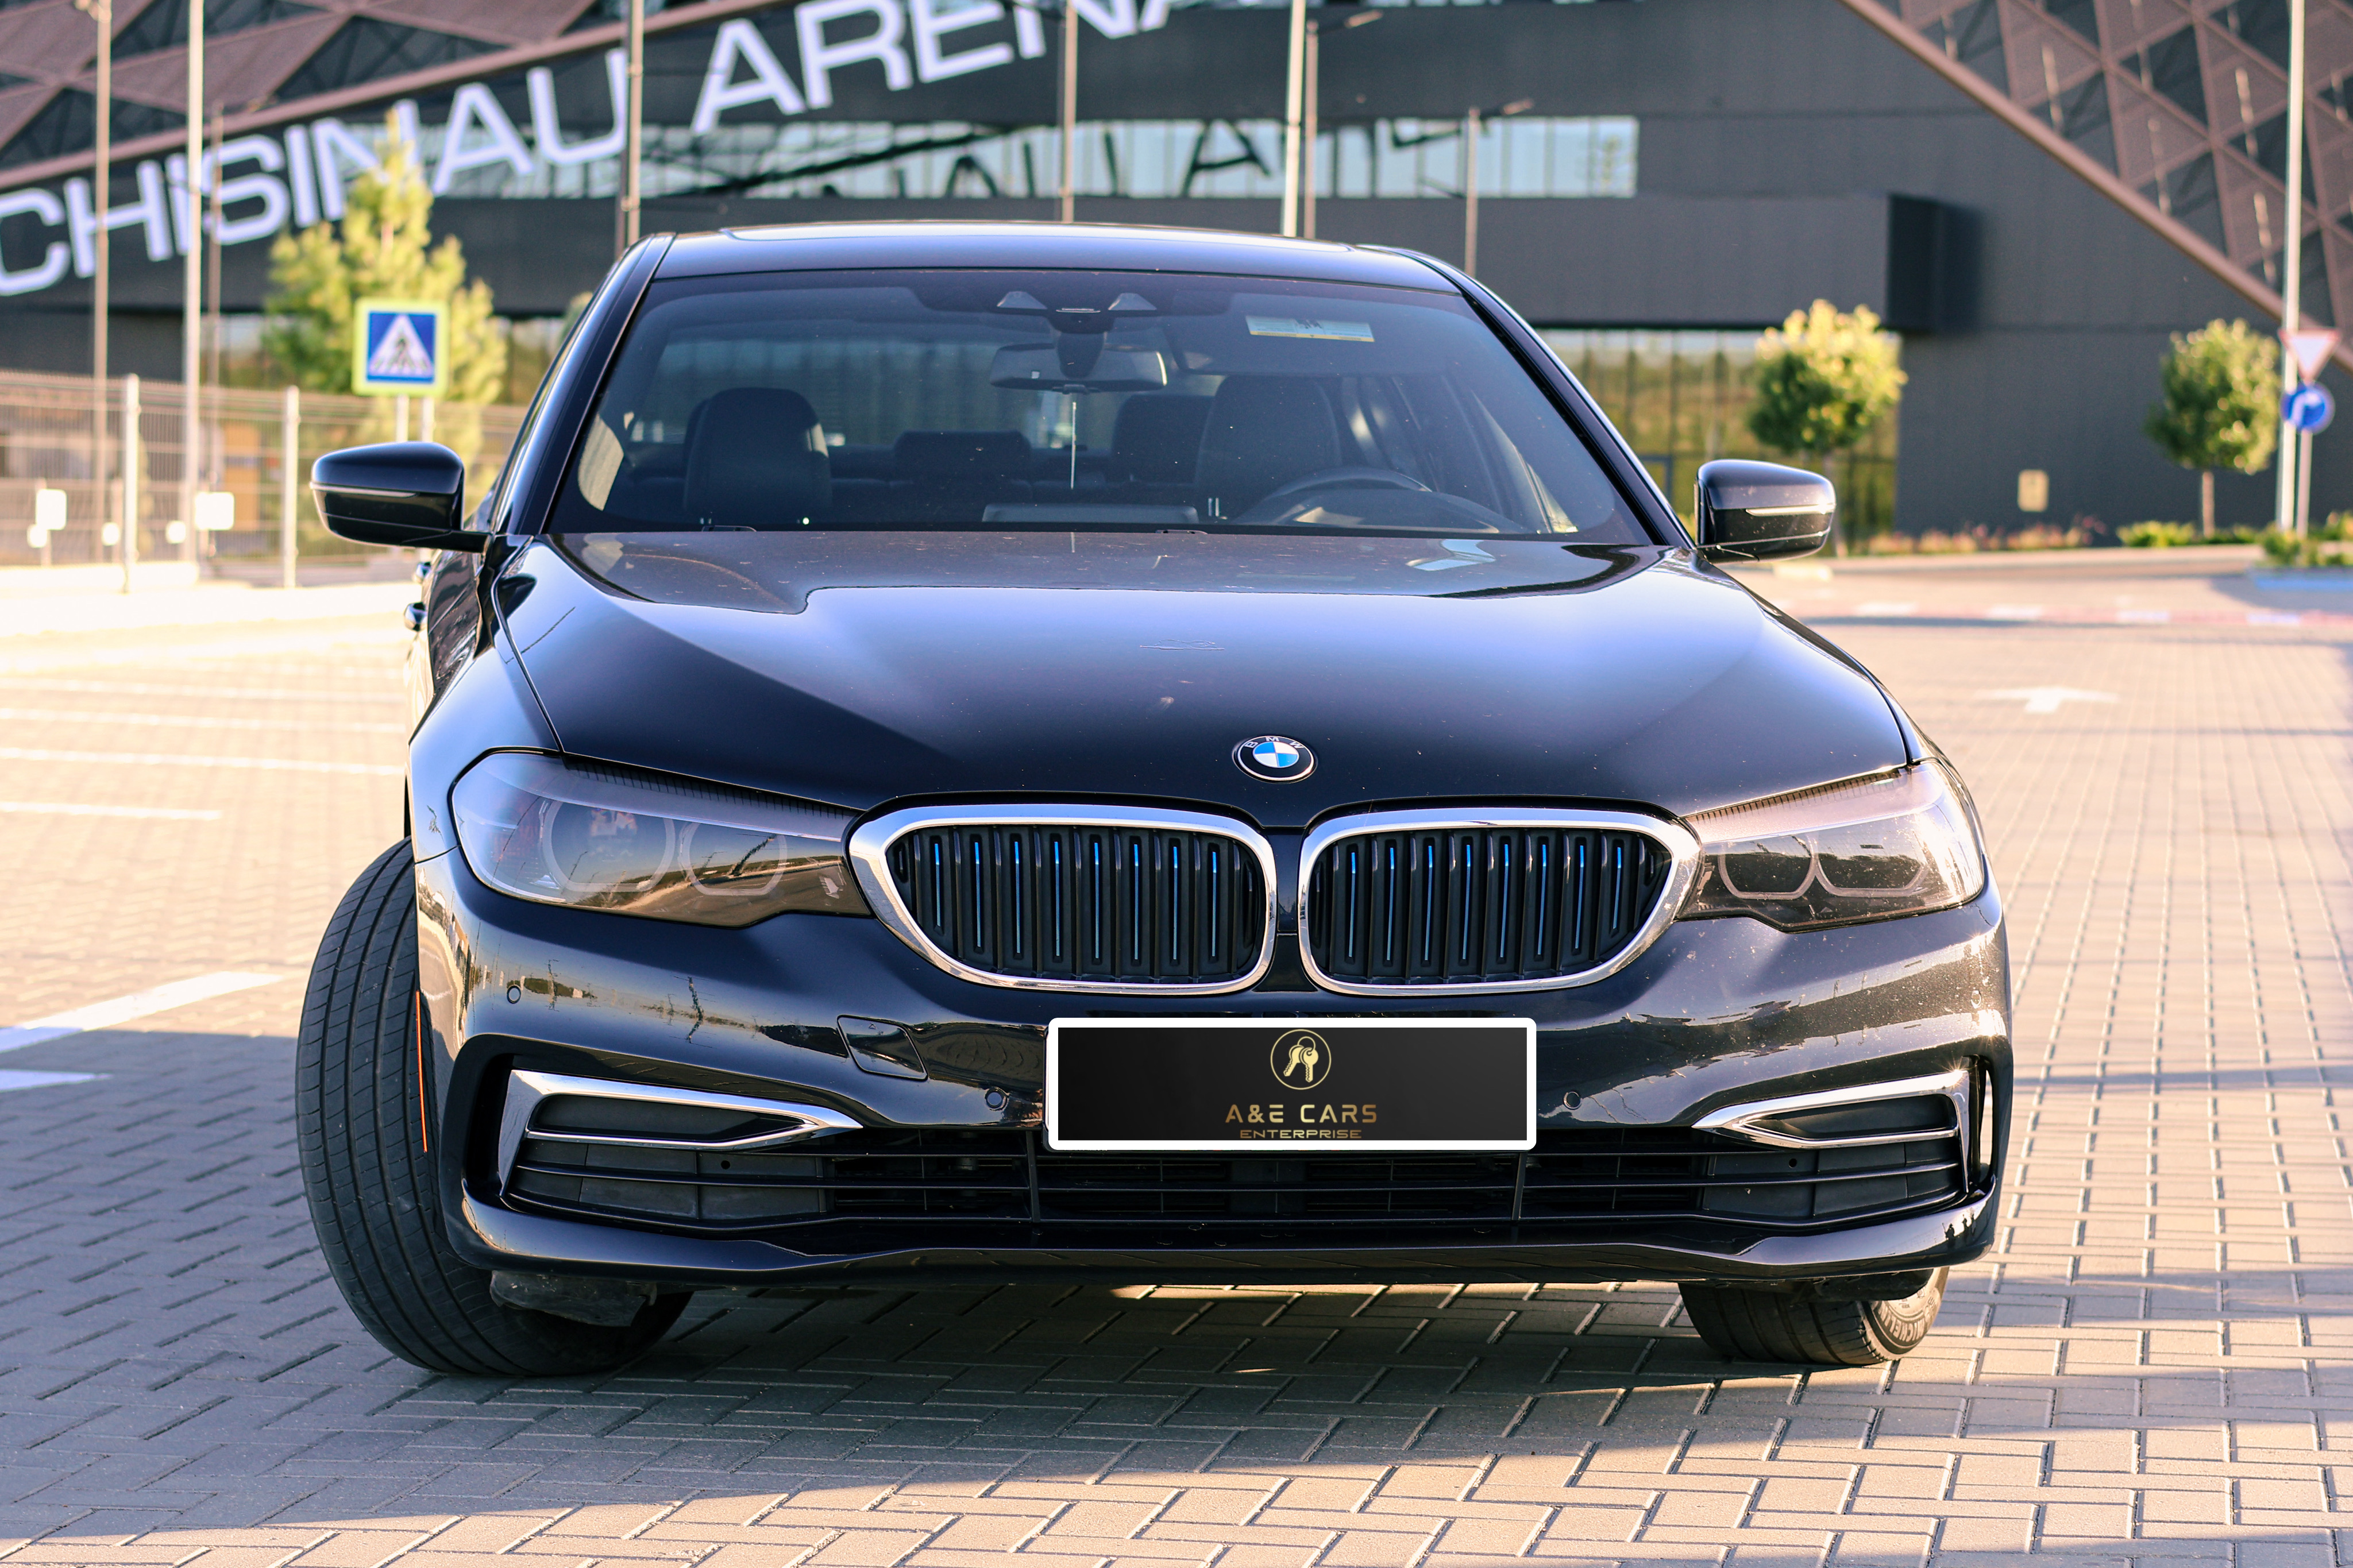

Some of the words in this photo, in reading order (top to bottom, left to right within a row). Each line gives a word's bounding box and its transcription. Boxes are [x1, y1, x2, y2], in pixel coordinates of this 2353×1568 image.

[0, 48, 627, 296] CHISINAU
[1245, 736, 1304, 749] BMW
[1877, 1300, 1925, 1342] MICHELIN
